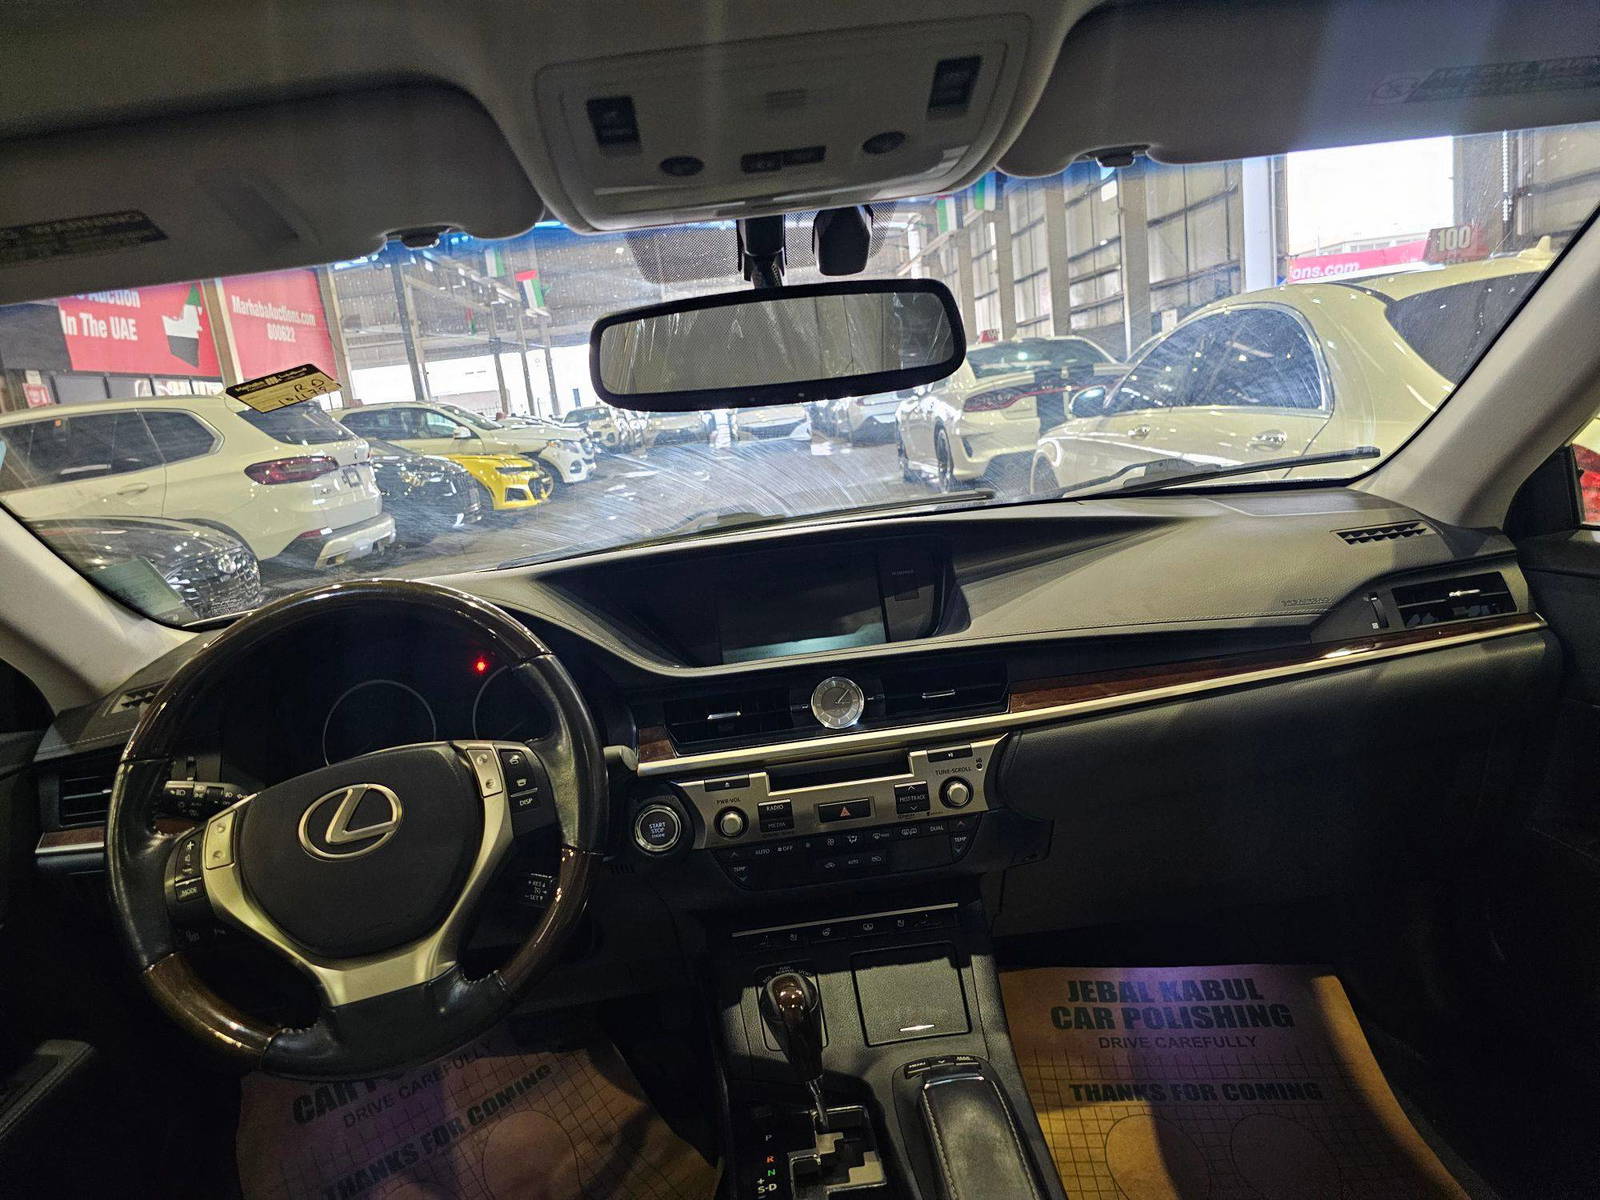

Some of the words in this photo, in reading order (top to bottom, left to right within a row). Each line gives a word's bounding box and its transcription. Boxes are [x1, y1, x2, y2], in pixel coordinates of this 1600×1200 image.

[1437, 226, 1472, 251] 100
[60, 309, 78, 335] In
[79, 312, 108, 338] The
[109, 316, 138, 341] UAE
[766, 804, 784, 812] RADIO
[1067, 980, 1155, 1003] JEBAL
[1159, 978, 1265, 1002] KABUL
[1050, 1005, 1116, 1030] CAR
[1121, 1003, 1296, 1030] POLISHING
[1098, 1036, 1151, 1050] DRIVE
[1155, 1036, 1257, 1049] CAREFULLY
[343, 1094, 395, 1128] DRIVE
[398, 1039, 498, 1100] CAREFULLY
[1068, 1083, 1167, 1101] THANKS
[1169, 1083, 1217, 1101] FOR
[1222, 1082, 1324, 1101] COMING
[420, 1116, 465, 1155] FOR
[466, 1062, 553, 1127] COMING
[765, 1134, 773, 1142] P
[766, 1155, 775, 1164] R
[767, 1168, 776, 1177] N
